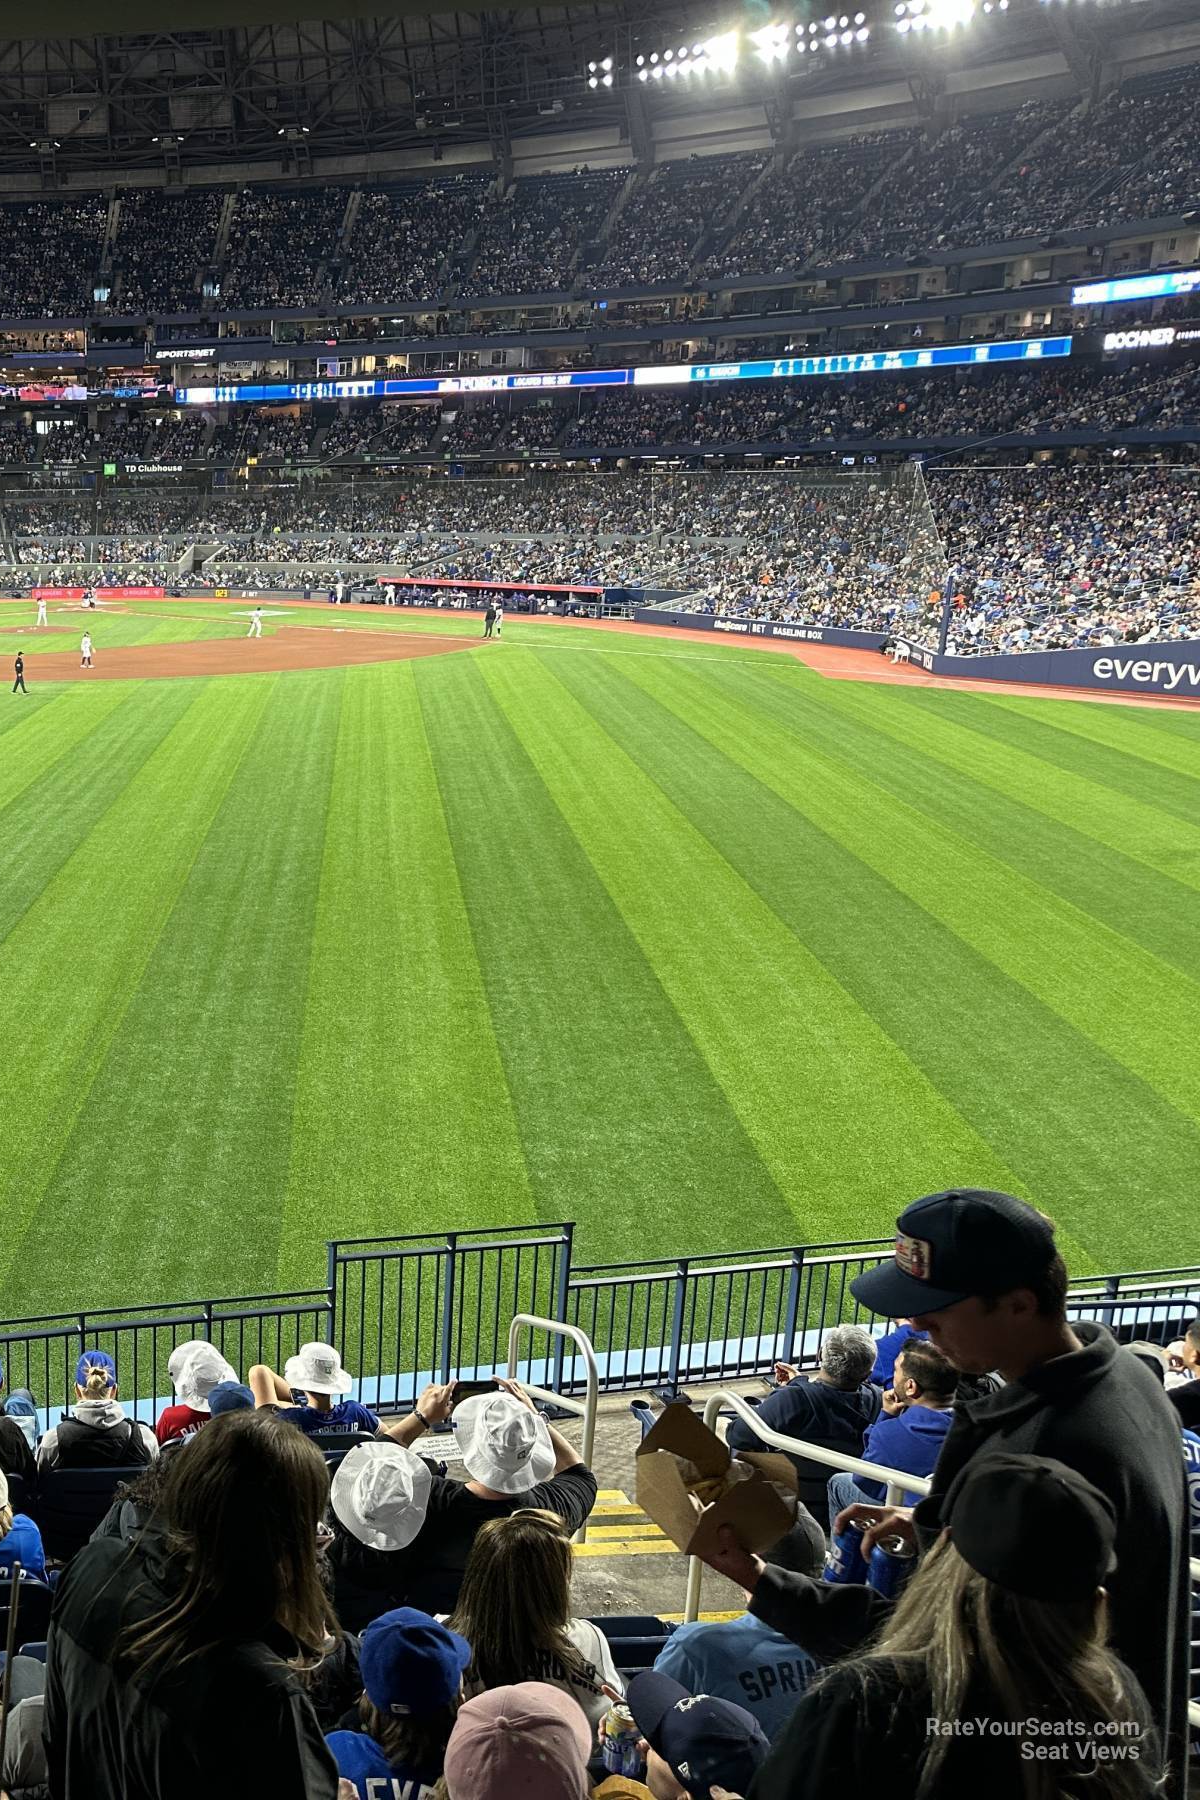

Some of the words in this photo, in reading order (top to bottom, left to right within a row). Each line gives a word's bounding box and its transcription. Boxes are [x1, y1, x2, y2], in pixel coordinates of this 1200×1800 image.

[155, 348, 216, 359] SPORTSNET
[138, 464, 183, 473] Clubhouse
[714, 620, 747, 632] theScore
[752, 623, 766, 634] BET
[772, 626, 806, 638] BASELINE
[807, 630, 823, 640] BOX
[923, 652, 933, 671] VISA
